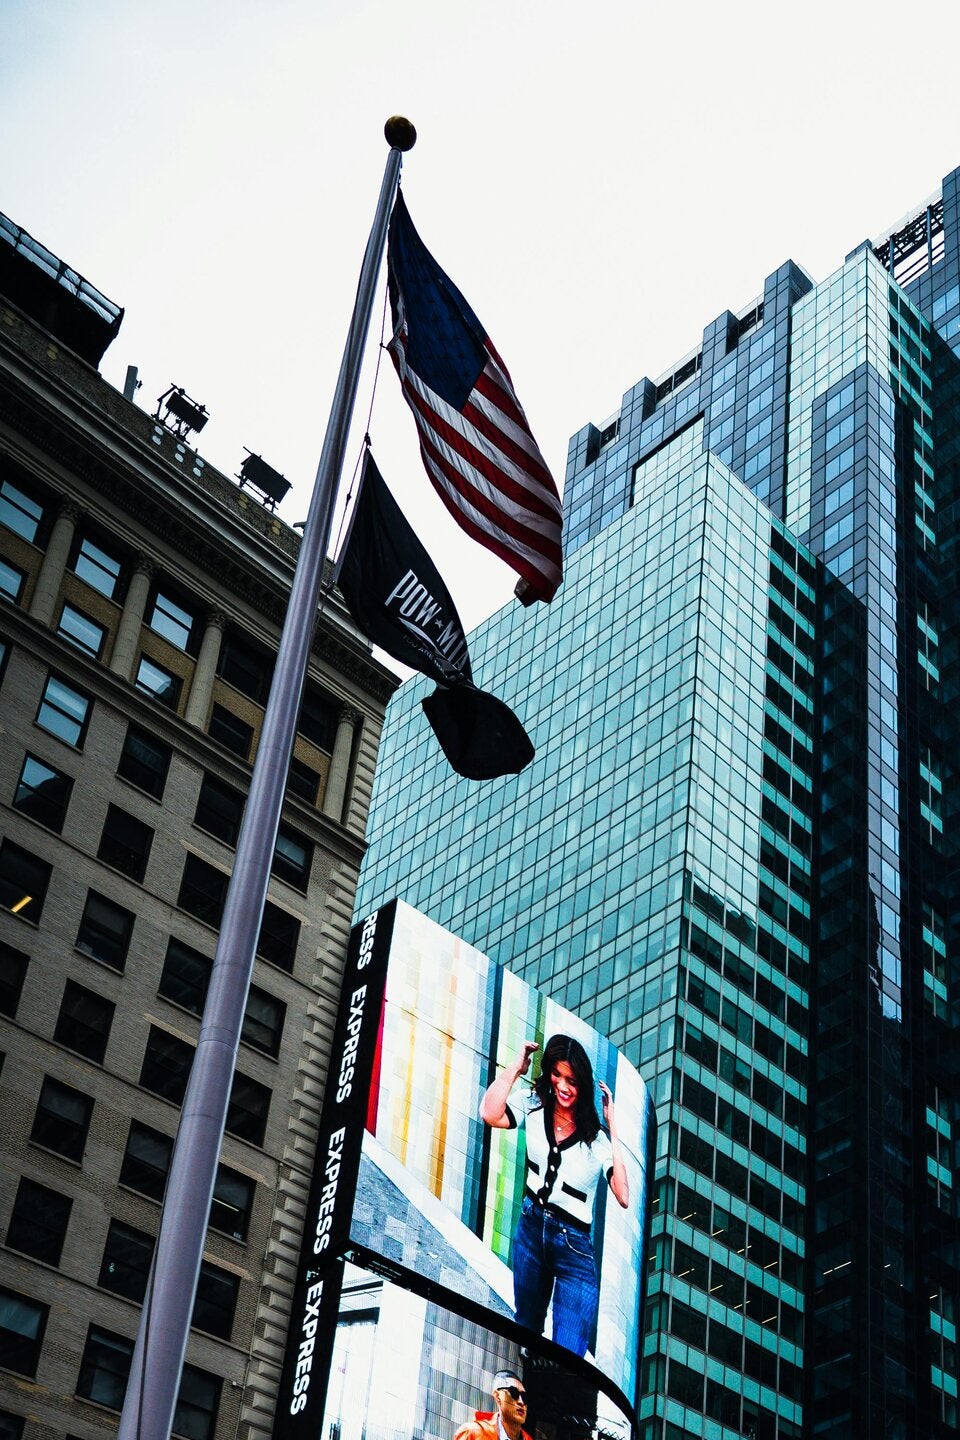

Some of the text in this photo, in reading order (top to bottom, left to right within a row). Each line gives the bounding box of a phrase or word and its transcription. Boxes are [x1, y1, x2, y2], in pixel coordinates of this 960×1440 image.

[384, 569, 441, 627] POW
[336, 984, 367, 1103] EXPRESS
[313, 1126, 346, 1255] EXPRESS
[290, 1280, 324, 1416] EXPRESS
